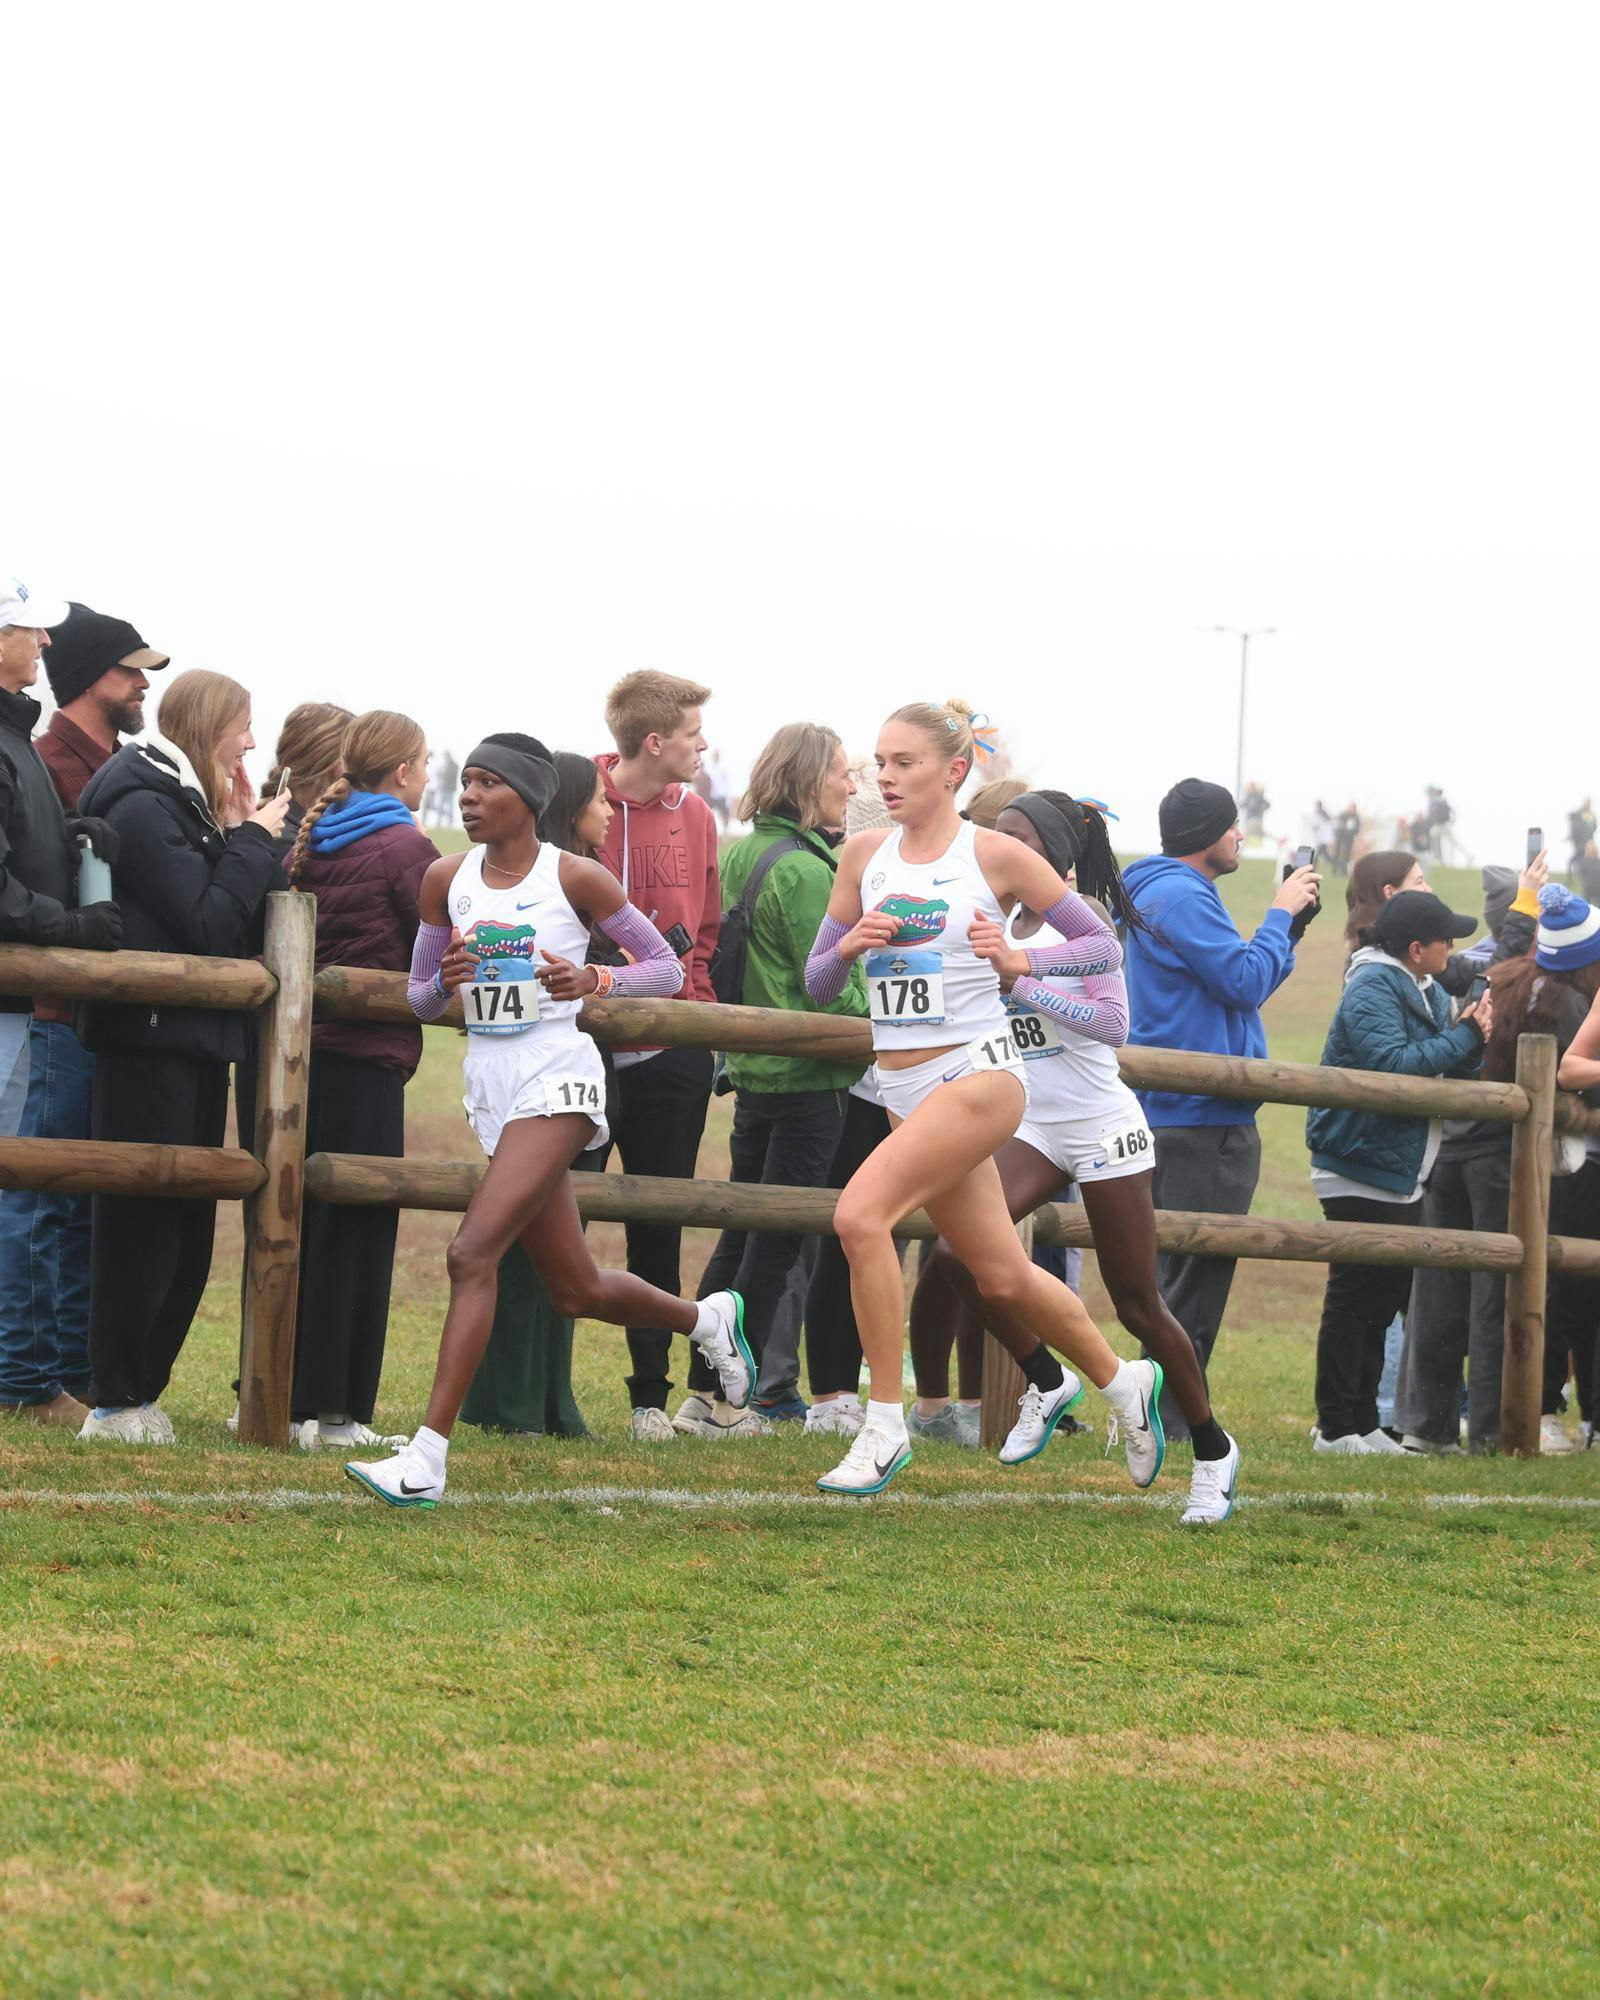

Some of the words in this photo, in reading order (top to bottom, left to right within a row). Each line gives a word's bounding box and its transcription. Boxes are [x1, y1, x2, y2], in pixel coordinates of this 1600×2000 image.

[471, 985, 524, 1021] 174
[877, 978, 930, 1015] 178
[1029, 987, 1095, 1023] GATORS
[1010, 1016, 1046, 1049] 68
[558, 1082, 599, 1108] 174
[1113, 1128, 1148, 1158] 168
